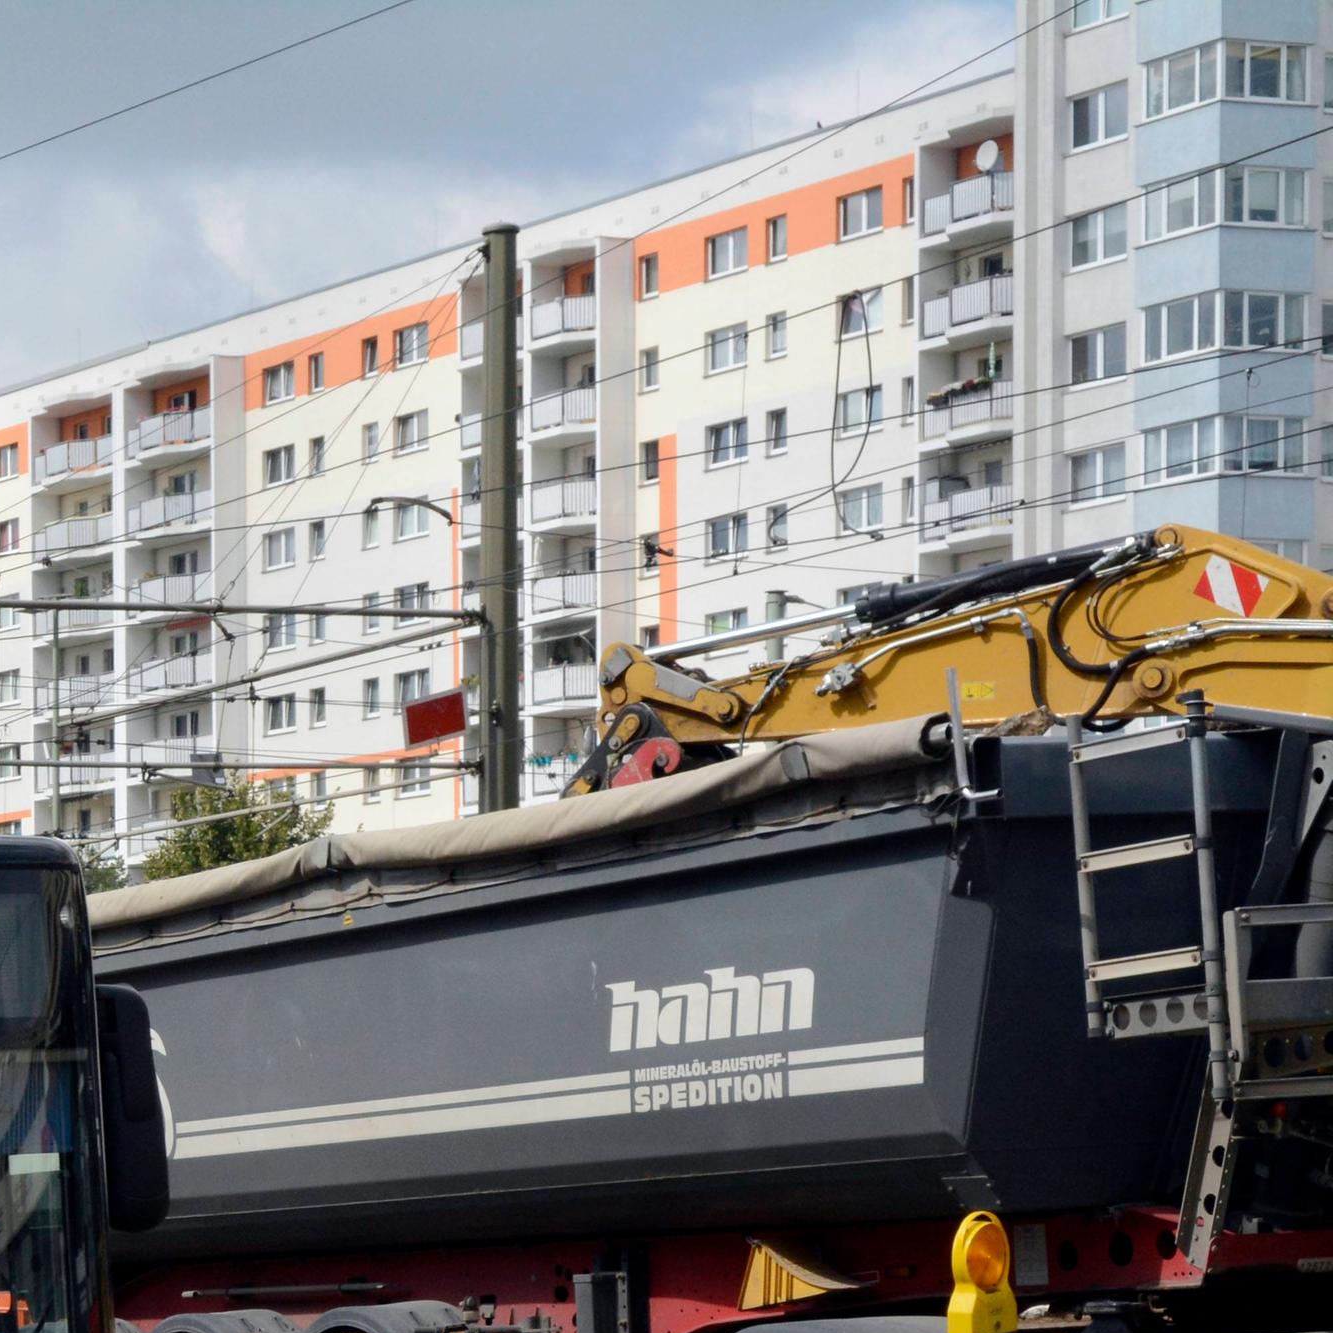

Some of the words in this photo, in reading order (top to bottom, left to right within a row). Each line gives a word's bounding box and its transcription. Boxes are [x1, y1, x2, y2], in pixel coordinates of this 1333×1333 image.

[605, 966, 815, 1052] hahn
[635, 1053, 786, 1082] MINERALÖL-BAUSTOFF-
[634, 1072, 783, 1113] SPEDITION
